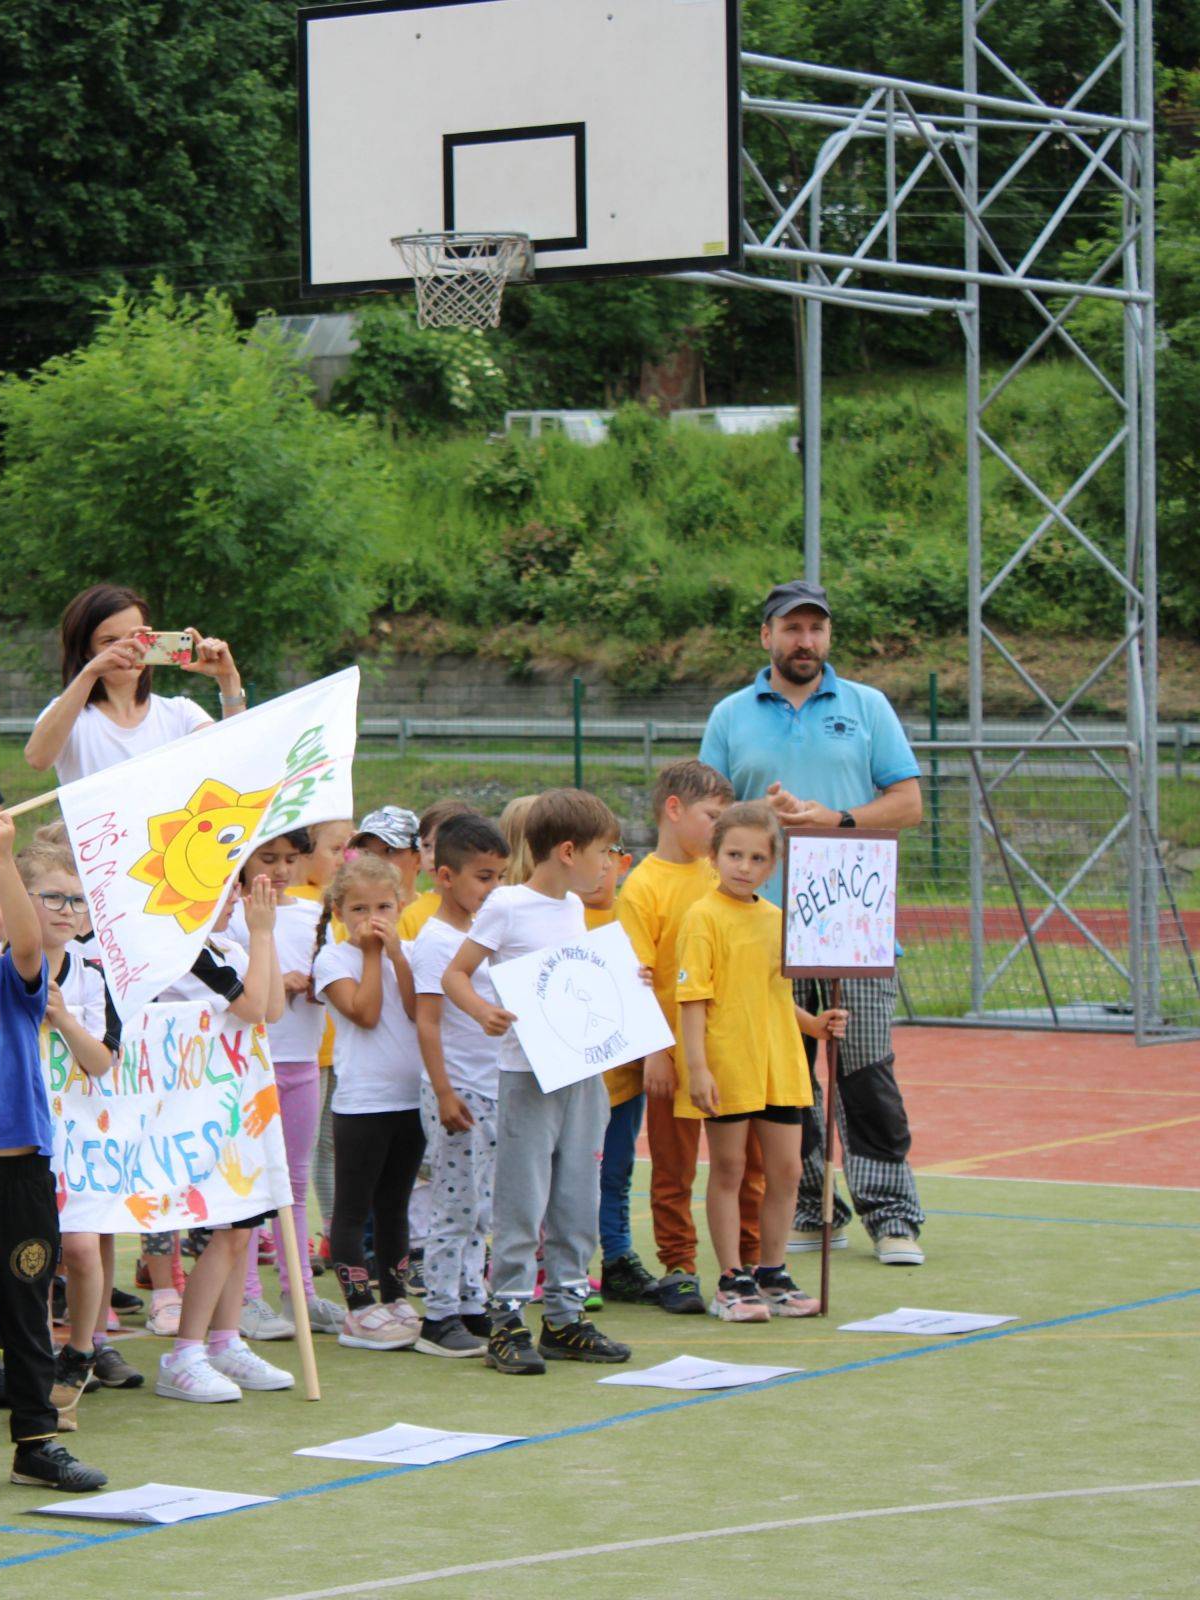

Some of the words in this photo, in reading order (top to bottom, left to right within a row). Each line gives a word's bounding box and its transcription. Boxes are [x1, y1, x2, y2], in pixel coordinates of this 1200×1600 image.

[75, 811, 129, 862] MŠ
[795, 855, 889, 927] BĚLÁČCI
[64, 1114, 154, 1194] ČESKÁ
[149, 1120, 224, 1185] VES
